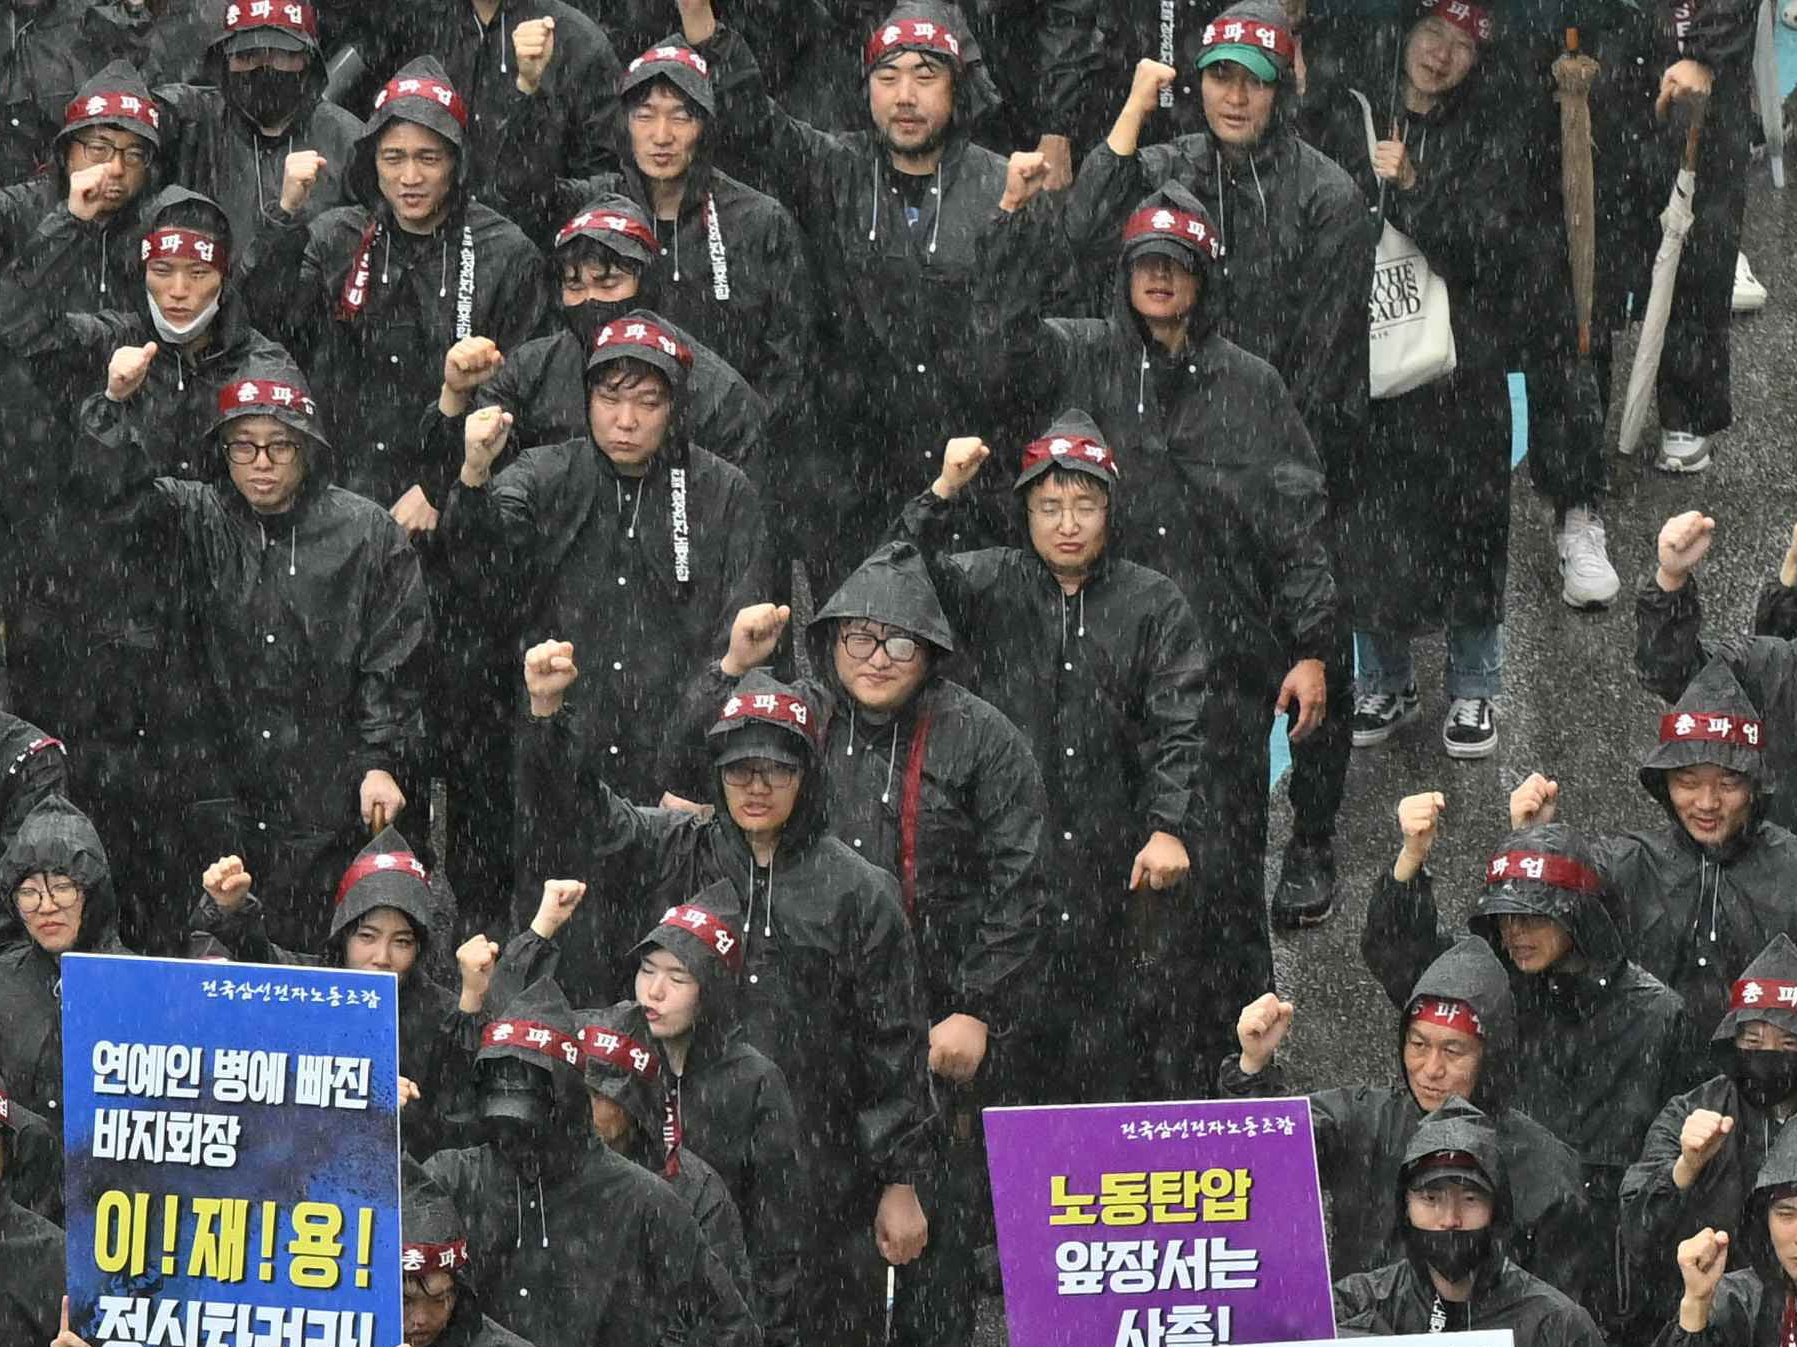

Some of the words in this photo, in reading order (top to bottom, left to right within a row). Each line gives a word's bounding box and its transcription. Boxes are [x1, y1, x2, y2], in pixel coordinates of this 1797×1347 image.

[92, 1041, 202, 1098] 연예인
[213, 1048, 285, 1103] 병에
[296, 1054, 371, 1109] 빠진
[93, 1109, 240, 1167] 바지회장
[1049, 1167, 1252, 1226] 노동탄압
[1057, 1238, 1260, 1293] 앞장서는
